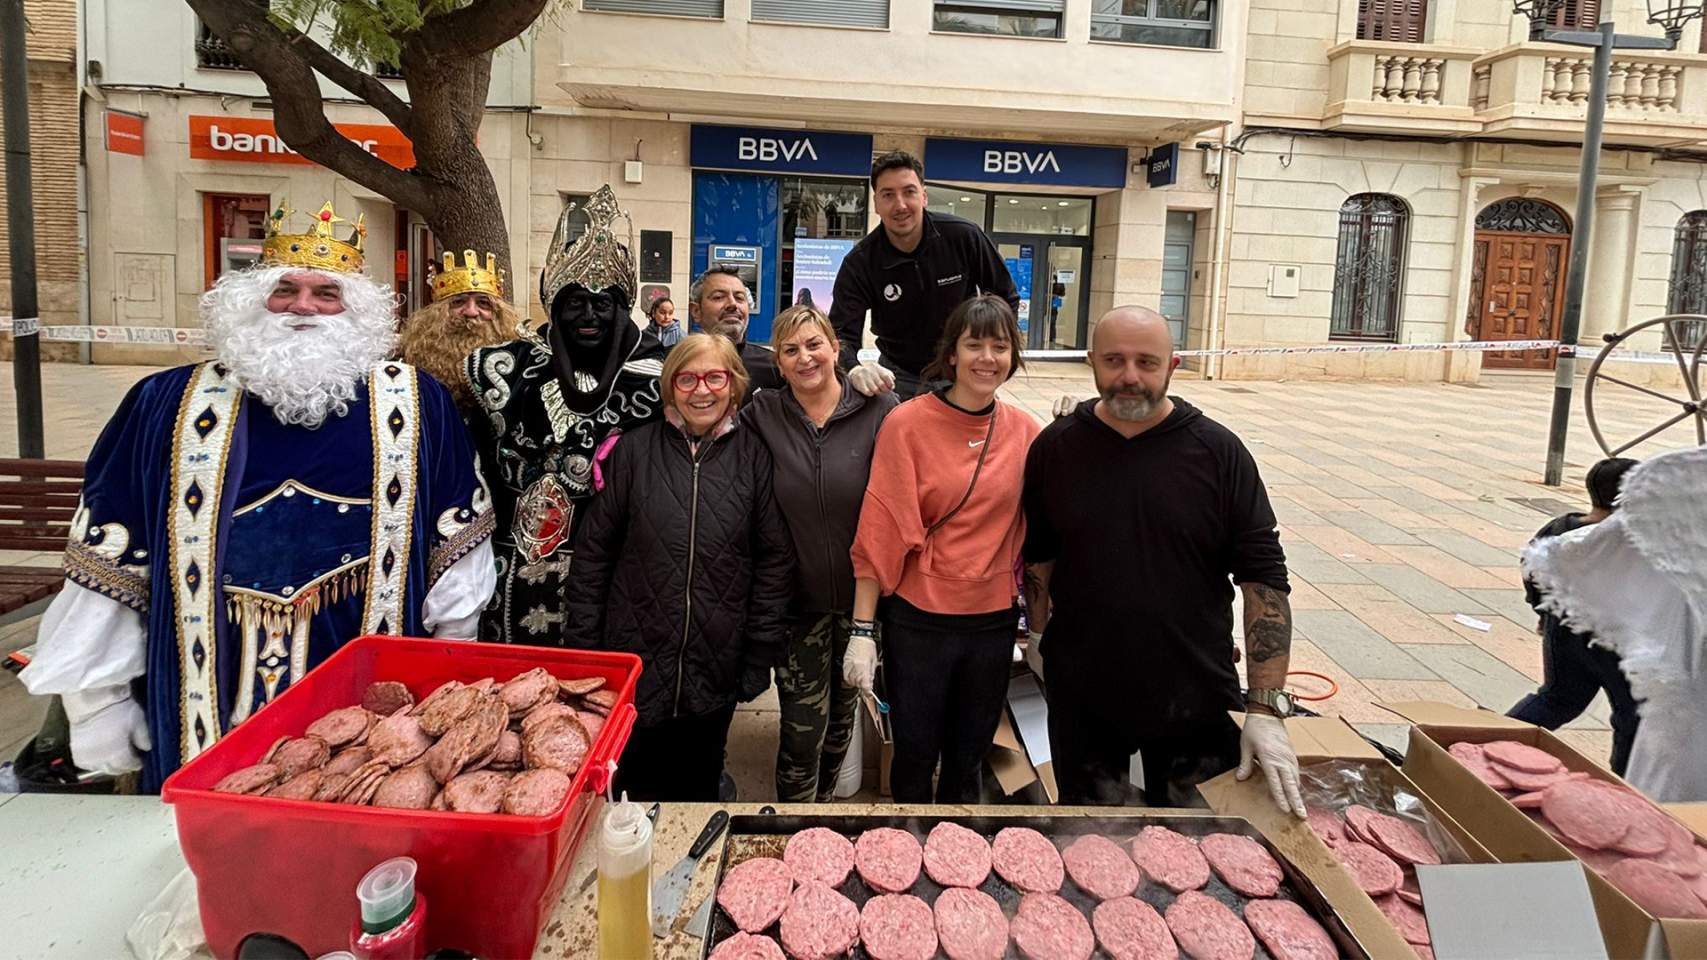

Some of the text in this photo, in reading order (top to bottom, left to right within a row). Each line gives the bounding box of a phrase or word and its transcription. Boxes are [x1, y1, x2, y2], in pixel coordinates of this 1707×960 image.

[738, 137, 818, 162] BBVA
[983, 150, 1061, 174] BBVA
[1152, 158, 1171, 173] BBVA
